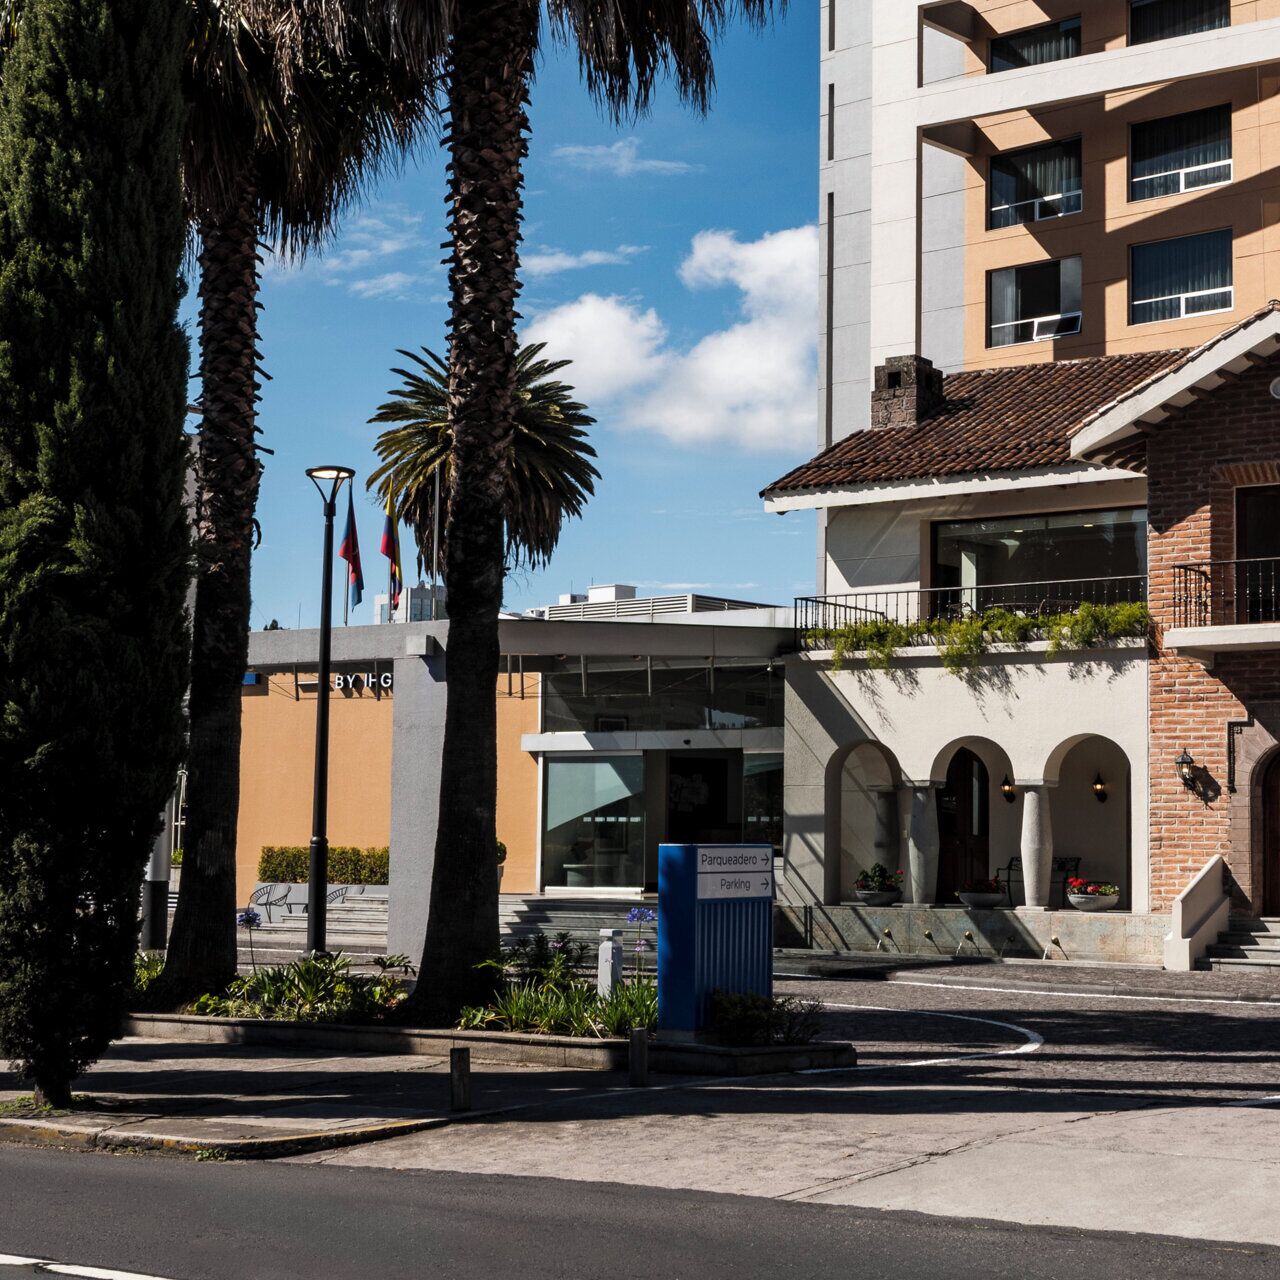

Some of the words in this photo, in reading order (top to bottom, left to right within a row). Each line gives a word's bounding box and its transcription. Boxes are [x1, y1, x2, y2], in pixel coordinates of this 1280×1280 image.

[335, 675, 355, 689] BY
[364, 673, 392, 688] IHG
[701, 853, 758, 866] Parqueadero
[720, 878, 751, 891] Parking
